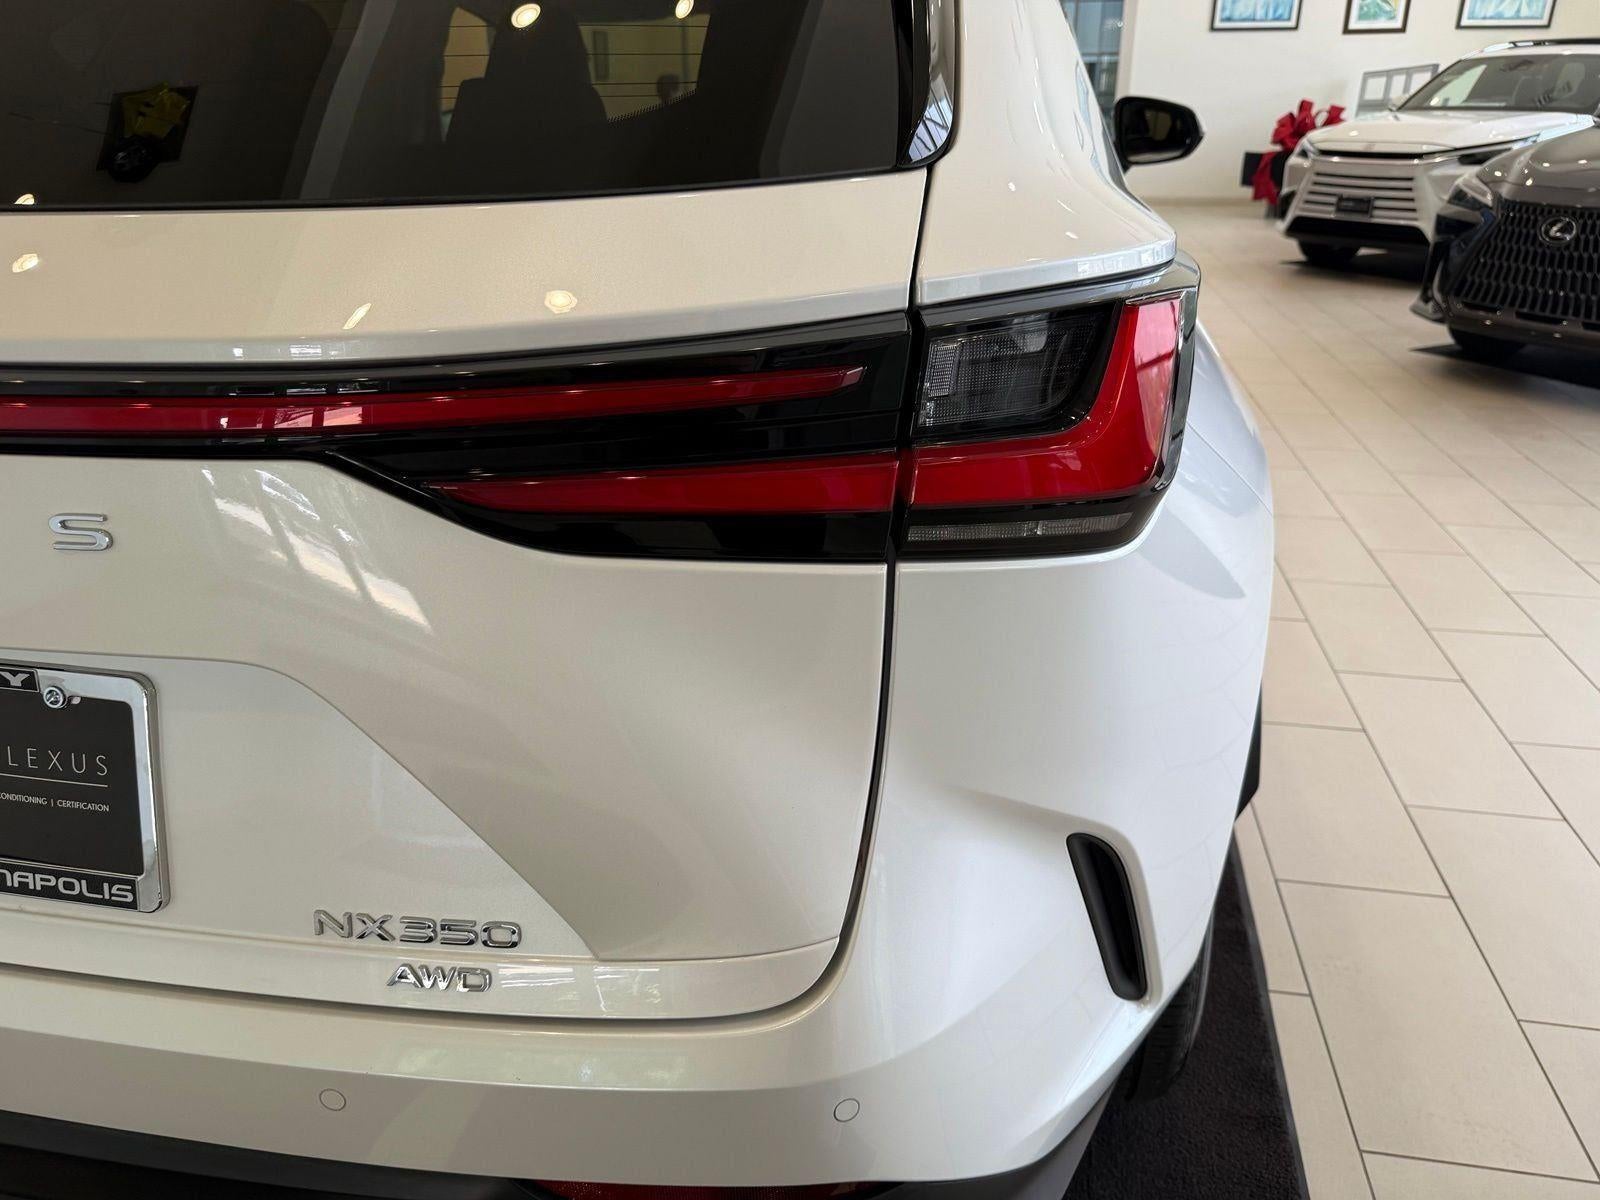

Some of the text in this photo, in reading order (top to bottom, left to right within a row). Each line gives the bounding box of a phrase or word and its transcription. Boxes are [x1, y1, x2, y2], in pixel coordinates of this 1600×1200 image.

[48, 512, 113, 551] S
[7, 745, 108, 776] LEXUS
[0, 791, 110, 812] ONDITIONING CERTIFICATION
[313, 909, 522, 949] NX350
[387, 963, 493, 993] AWD
